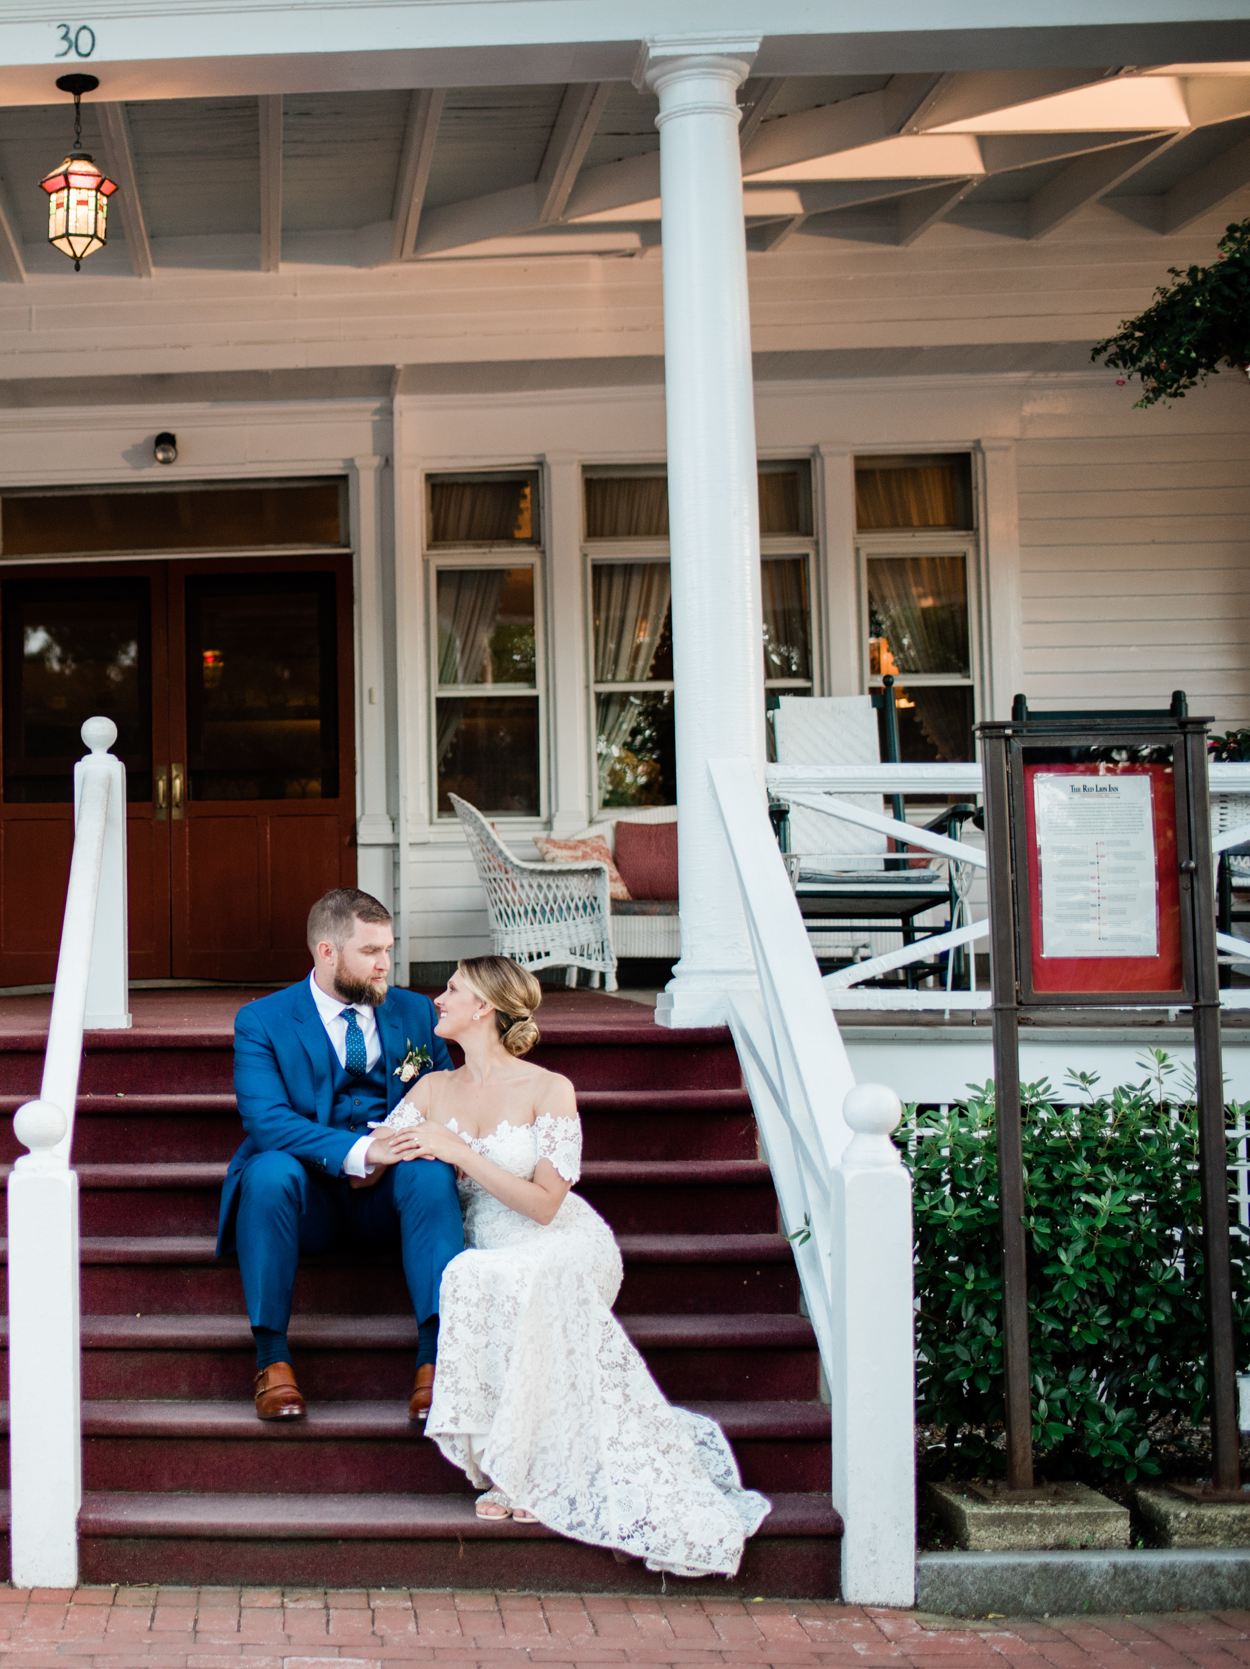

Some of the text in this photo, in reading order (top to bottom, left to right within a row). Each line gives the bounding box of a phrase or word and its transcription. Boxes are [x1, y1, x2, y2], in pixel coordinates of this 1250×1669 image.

[55, 24, 96, 58] 30
[1069, 783, 1119, 793] THE RED LION INN
